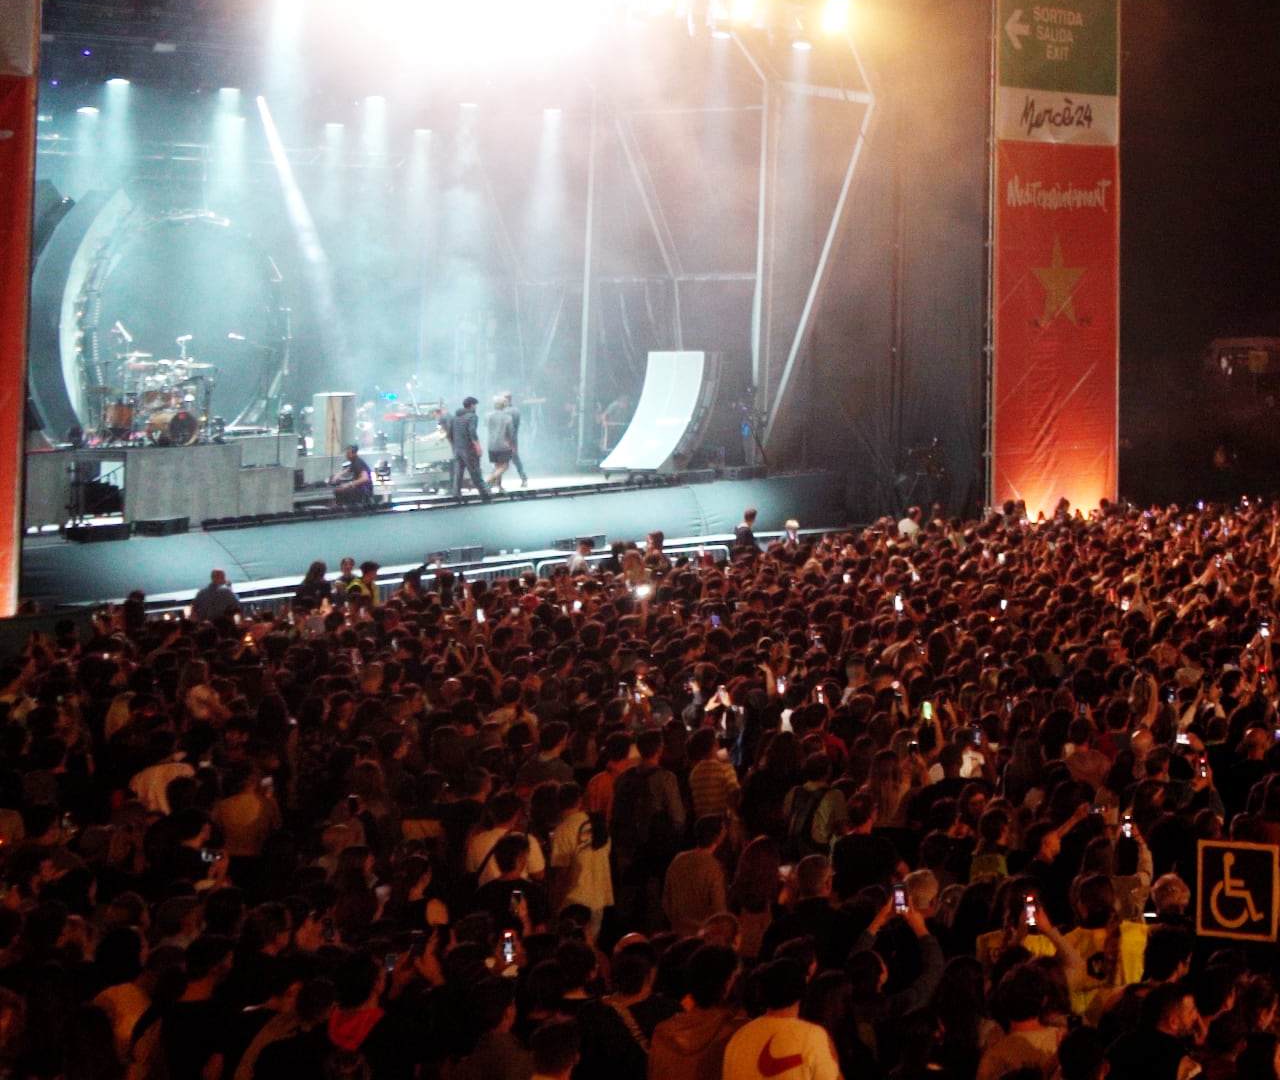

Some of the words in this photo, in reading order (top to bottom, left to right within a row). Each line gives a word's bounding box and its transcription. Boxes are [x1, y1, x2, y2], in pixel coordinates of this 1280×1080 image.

[1033, 6, 1083, 26] SORTIDA
[1036, 24, 1074, 42] SALIDA
[1046, 44, 1069, 60] EXIT
